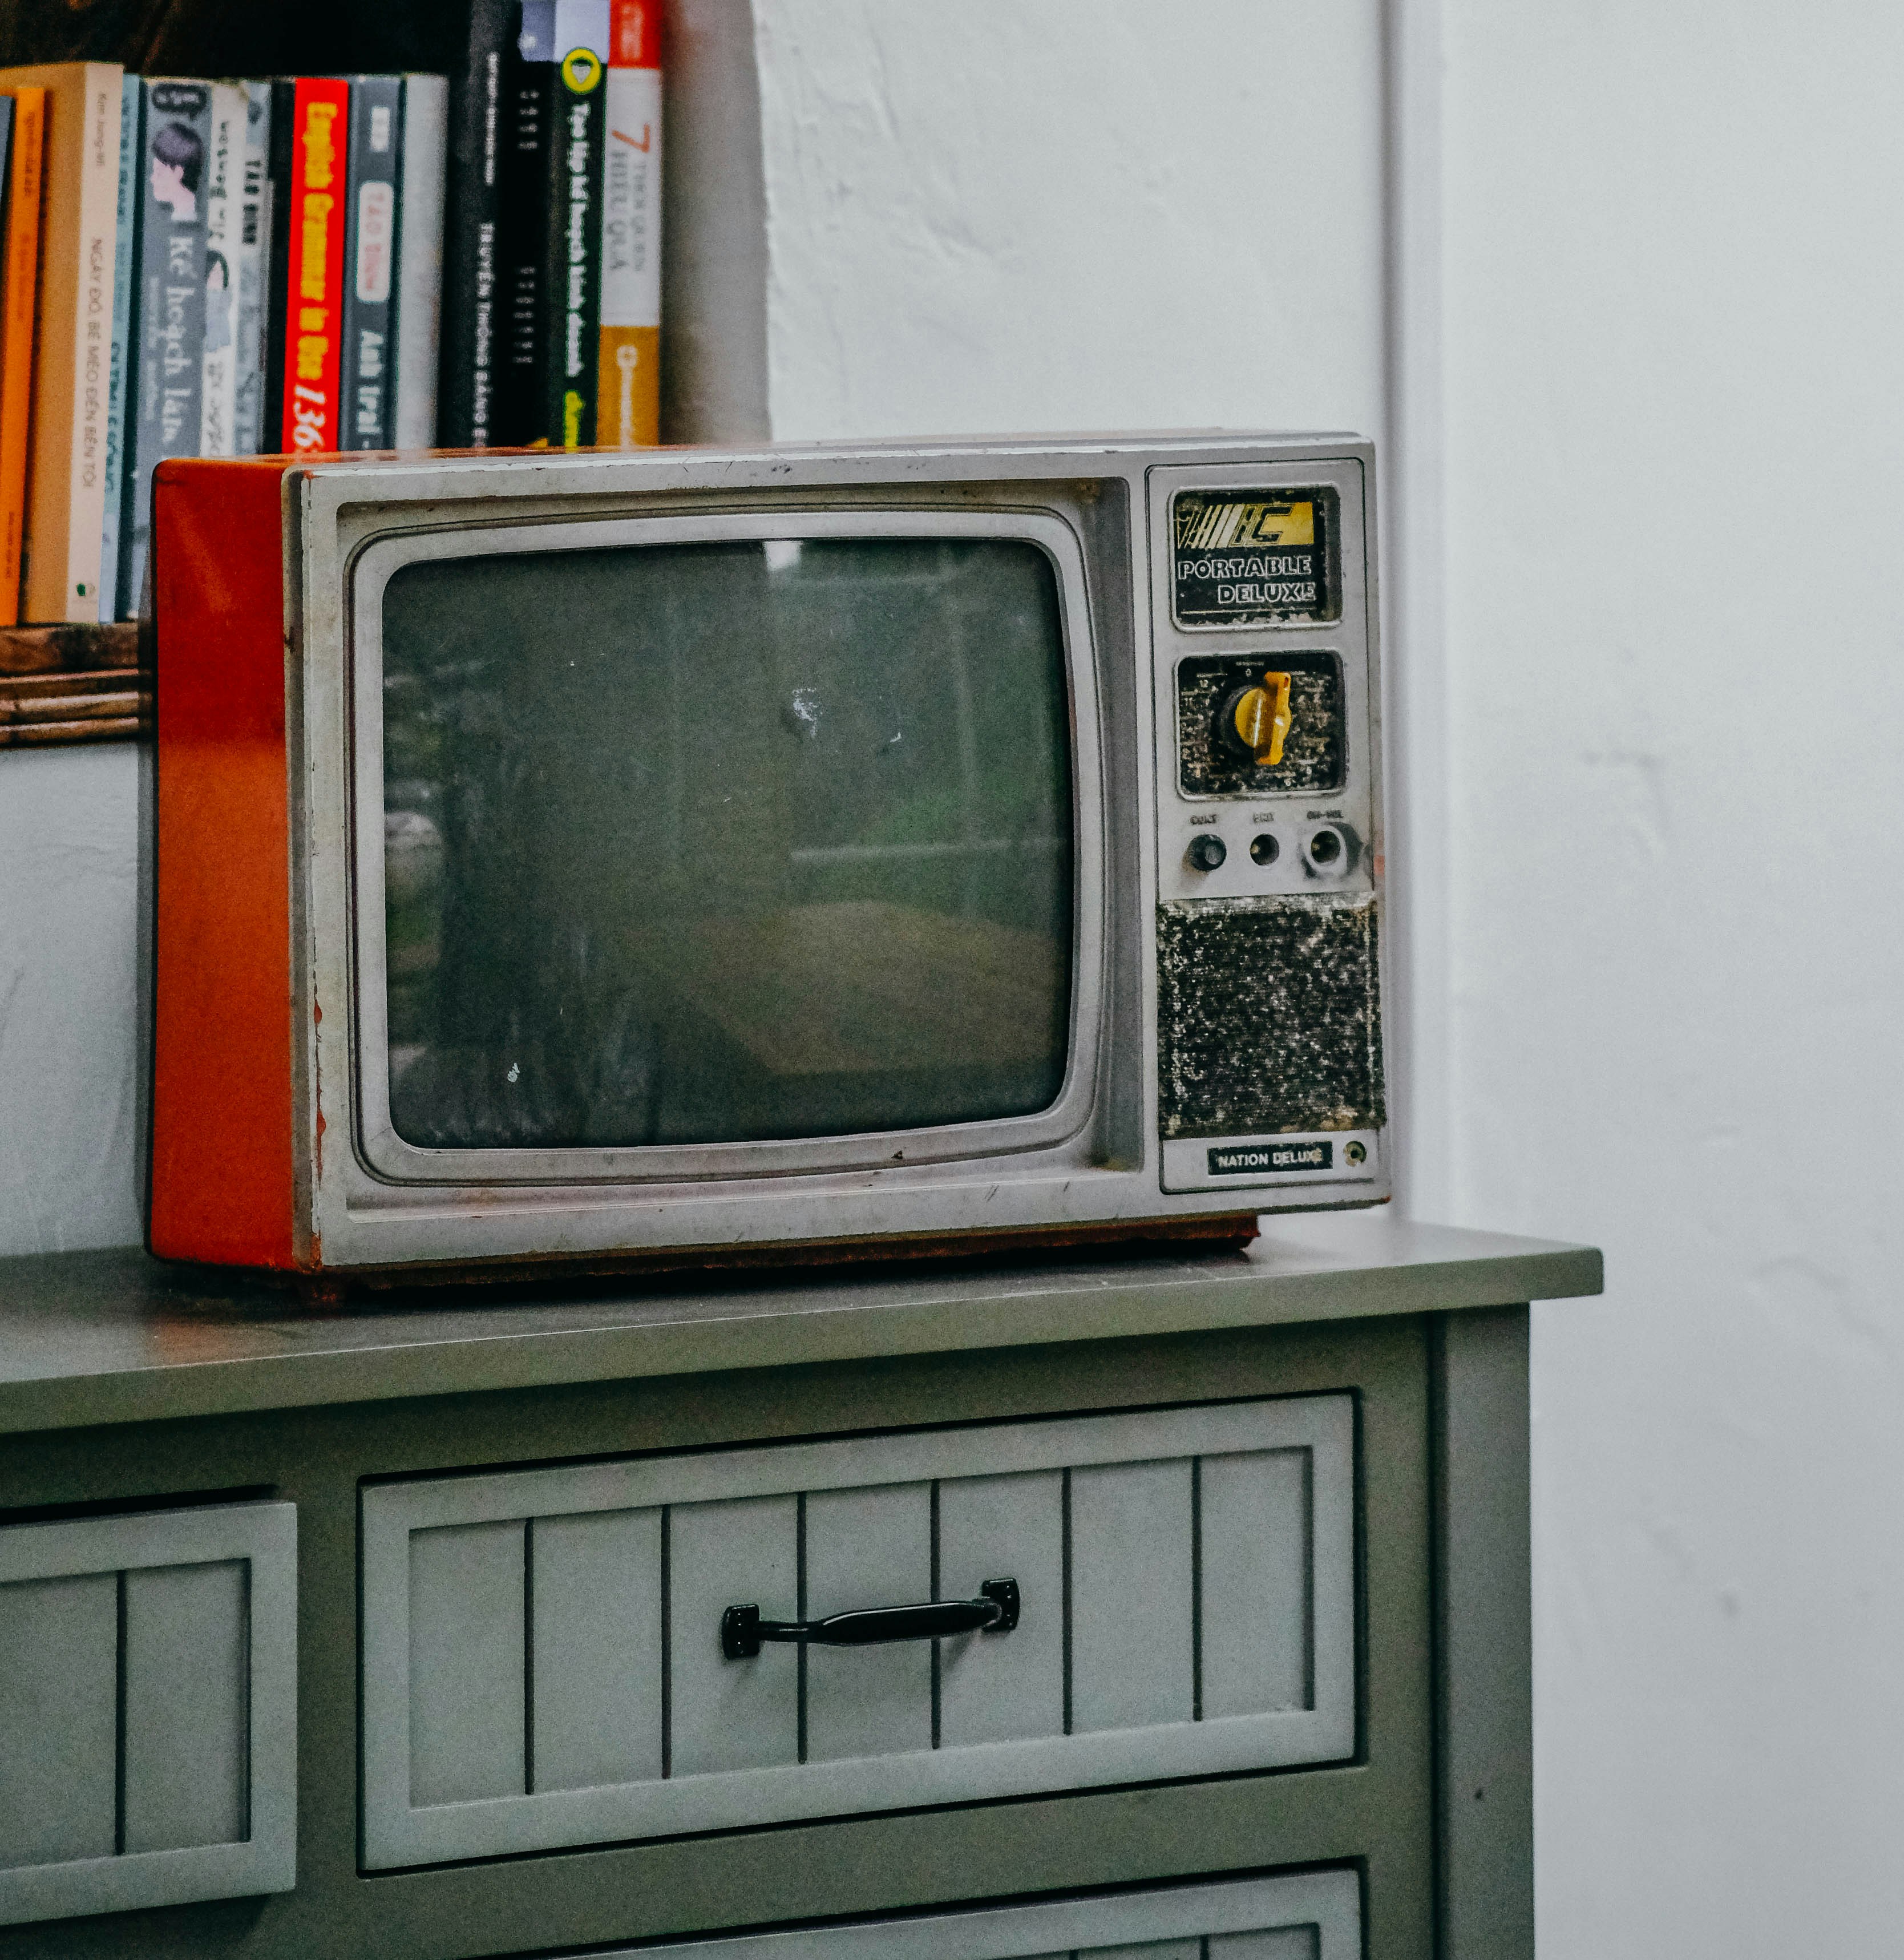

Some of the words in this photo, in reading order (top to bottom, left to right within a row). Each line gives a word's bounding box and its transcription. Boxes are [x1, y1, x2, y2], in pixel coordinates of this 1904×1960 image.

[1178, 556, 1312, 579] PORTABLE
[1218, 582, 1316, 604] DELUXE
[1218, 1153, 1268, 1167] NATION
[1272, 1148, 1323, 1164] DELUXE
